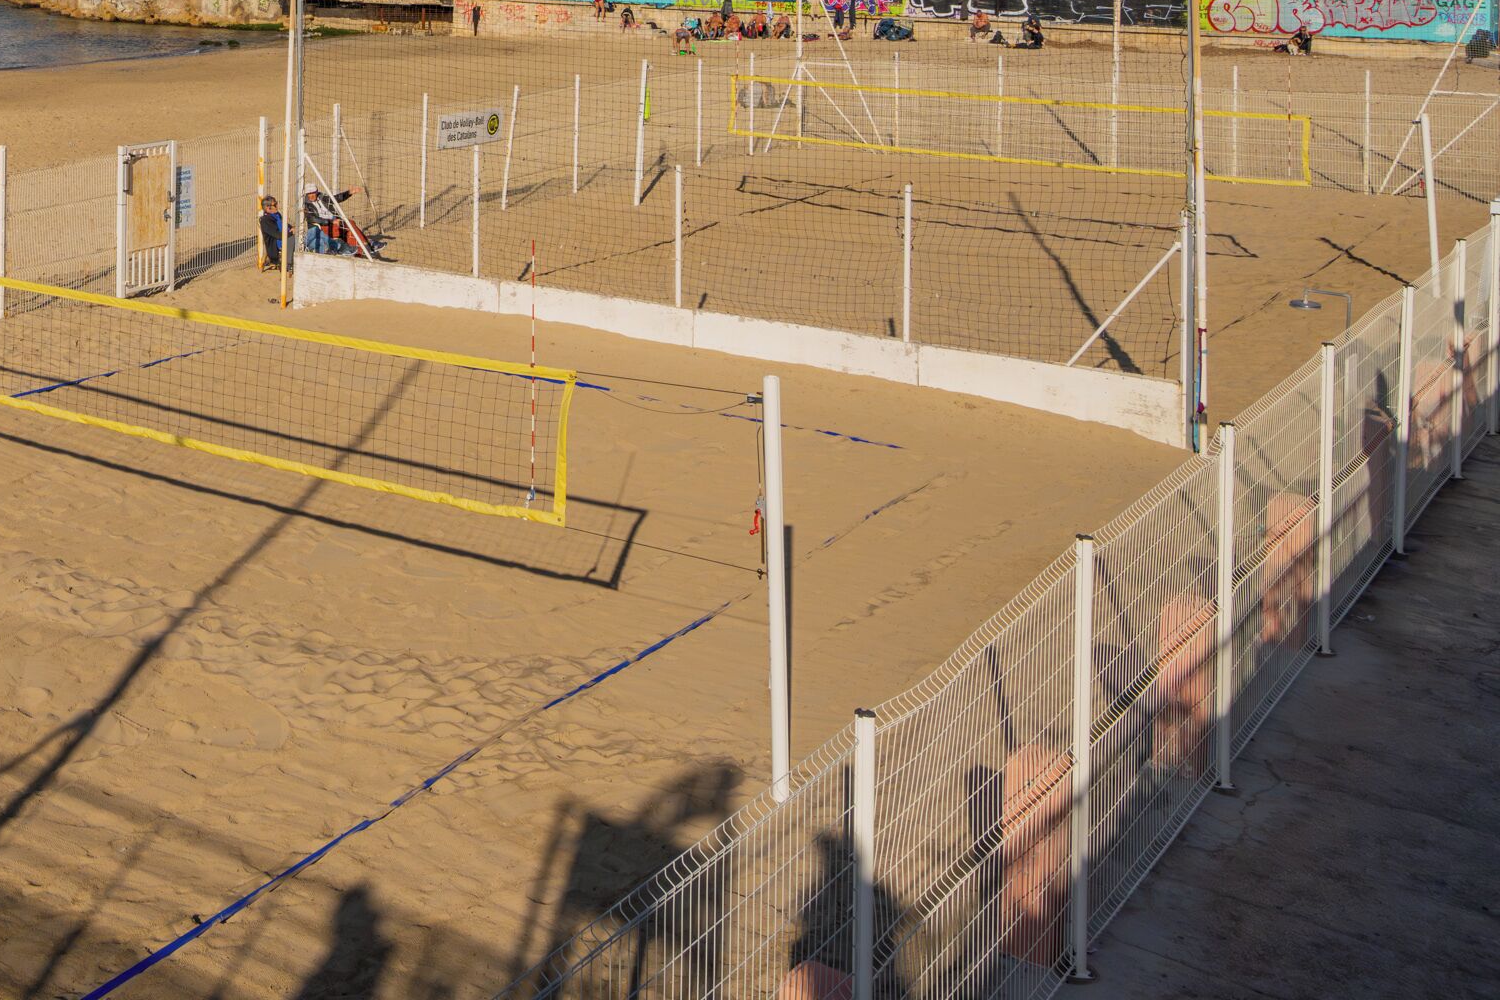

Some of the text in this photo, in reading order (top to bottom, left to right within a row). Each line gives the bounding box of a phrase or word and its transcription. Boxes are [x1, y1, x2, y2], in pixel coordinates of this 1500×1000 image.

[441, 120, 453, 130] Club
[453, 119, 460, 128] de
[447, 130, 477, 142] des Catalans
